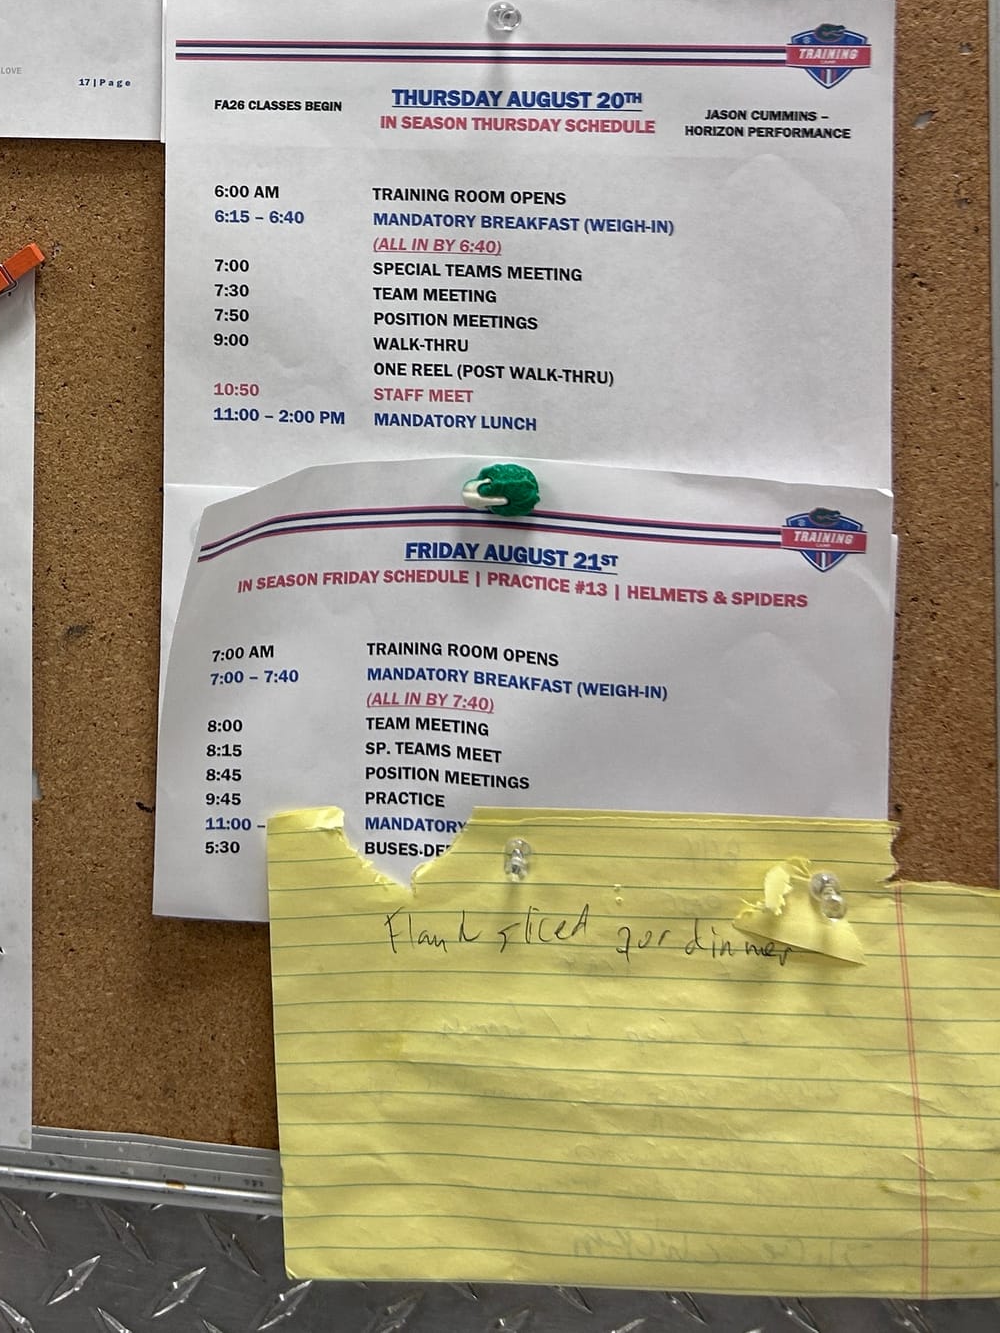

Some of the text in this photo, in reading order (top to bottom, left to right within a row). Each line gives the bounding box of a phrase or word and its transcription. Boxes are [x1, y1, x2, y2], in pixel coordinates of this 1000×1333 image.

[799, 48, 858, 60] TRAINING
[214, 99, 343, 112] FA26 CLASSES BEGIN
[391, 88, 643, 110] THURSDAY AUGUST 20TH
[380, 115, 657, 134] IN SEASON THURSDAY SCHEDULE
[684, 125, 852, 140] HORIZON PERFORMANCE
[373, 362, 614, 387] ONE REEL (POST WALK-THRU)
[794, 530, 854, 545] TRAINING
[405, 541, 479, 563] FRIDAY
[484, 544, 569, 567] AUGUST
[367, 667, 668, 703] MANDATORY BREAKFAST (WEIGH-IN)
[366, 693, 495, 715] (ALL IN BY 7:40)
[365, 791, 446, 809] PRACTICE
